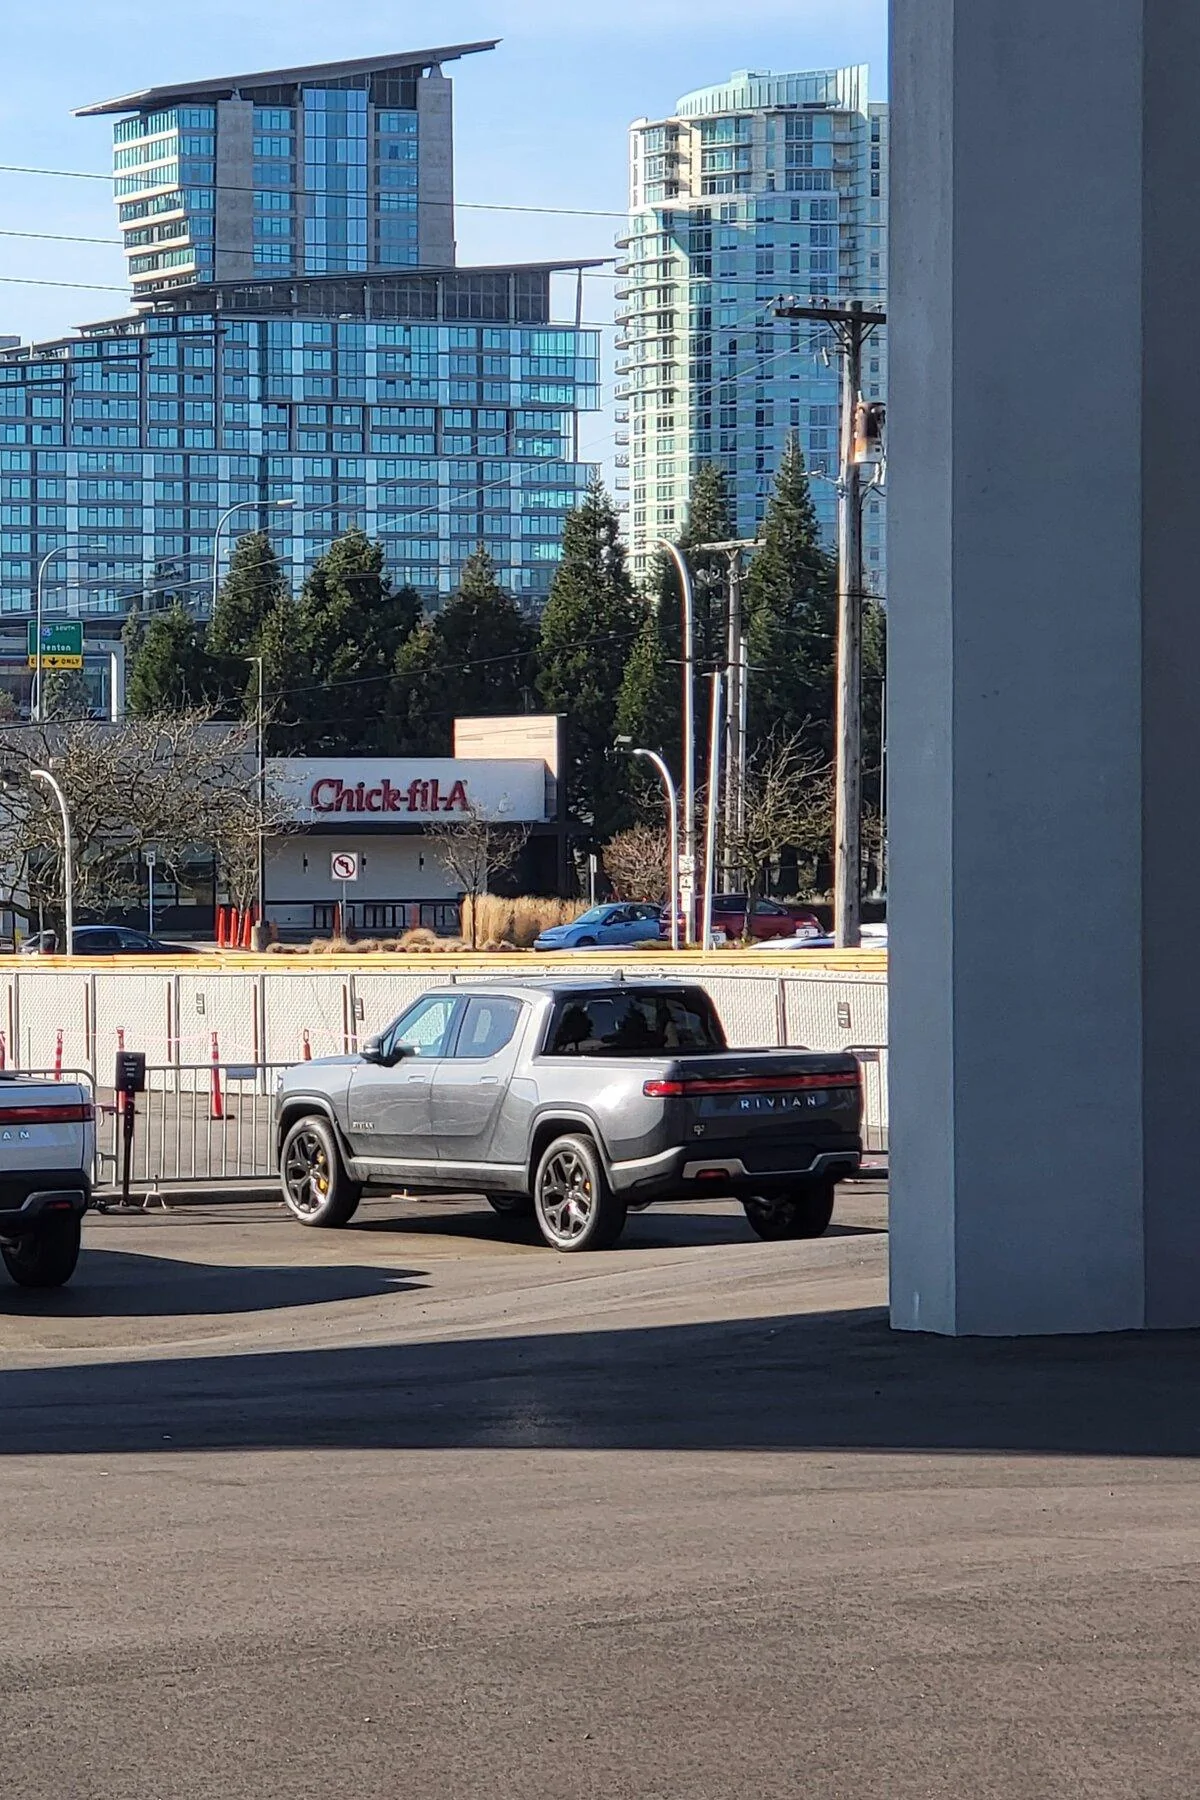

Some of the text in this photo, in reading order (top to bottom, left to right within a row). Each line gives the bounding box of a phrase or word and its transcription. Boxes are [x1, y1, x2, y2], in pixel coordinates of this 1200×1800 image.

[41, 643, 71, 651] Renton
[31, 657, 79, 665] ET ONLY
[310, 778, 469, 812] Chick-fil-A
[740, 1097, 818, 1109] RIVIAN
